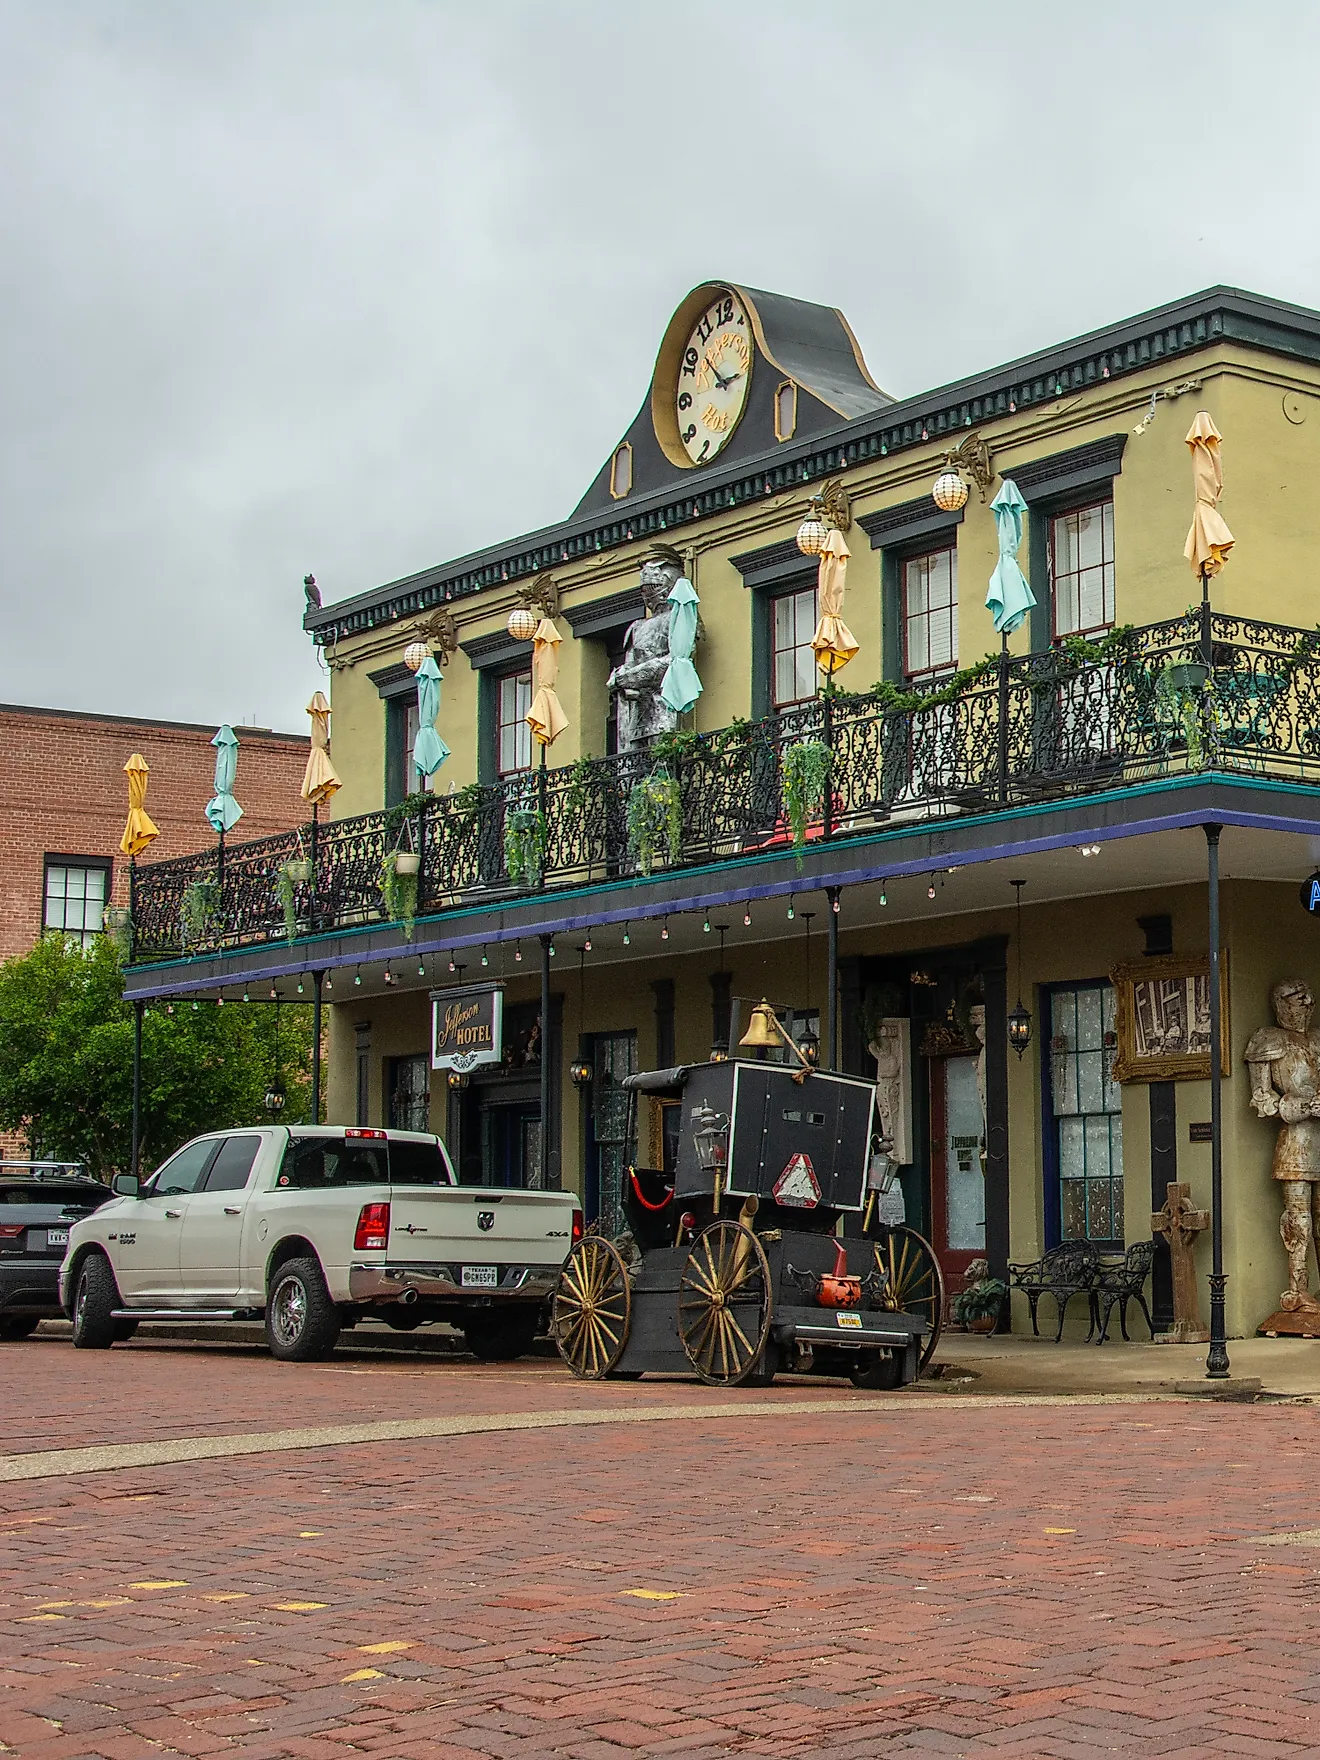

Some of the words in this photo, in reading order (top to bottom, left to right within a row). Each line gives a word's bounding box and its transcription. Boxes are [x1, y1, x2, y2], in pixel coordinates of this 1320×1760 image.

[715, 298, 734, 329] 12
[697, 315, 714, 346] 11
[683, 347, 699, 377] 10
[678, 392, 692, 411] 9
[682, 423, 697, 444] 8
[438, 1002, 480, 1048] Jefferson
[456, 1024, 492, 1046] HOTEL
